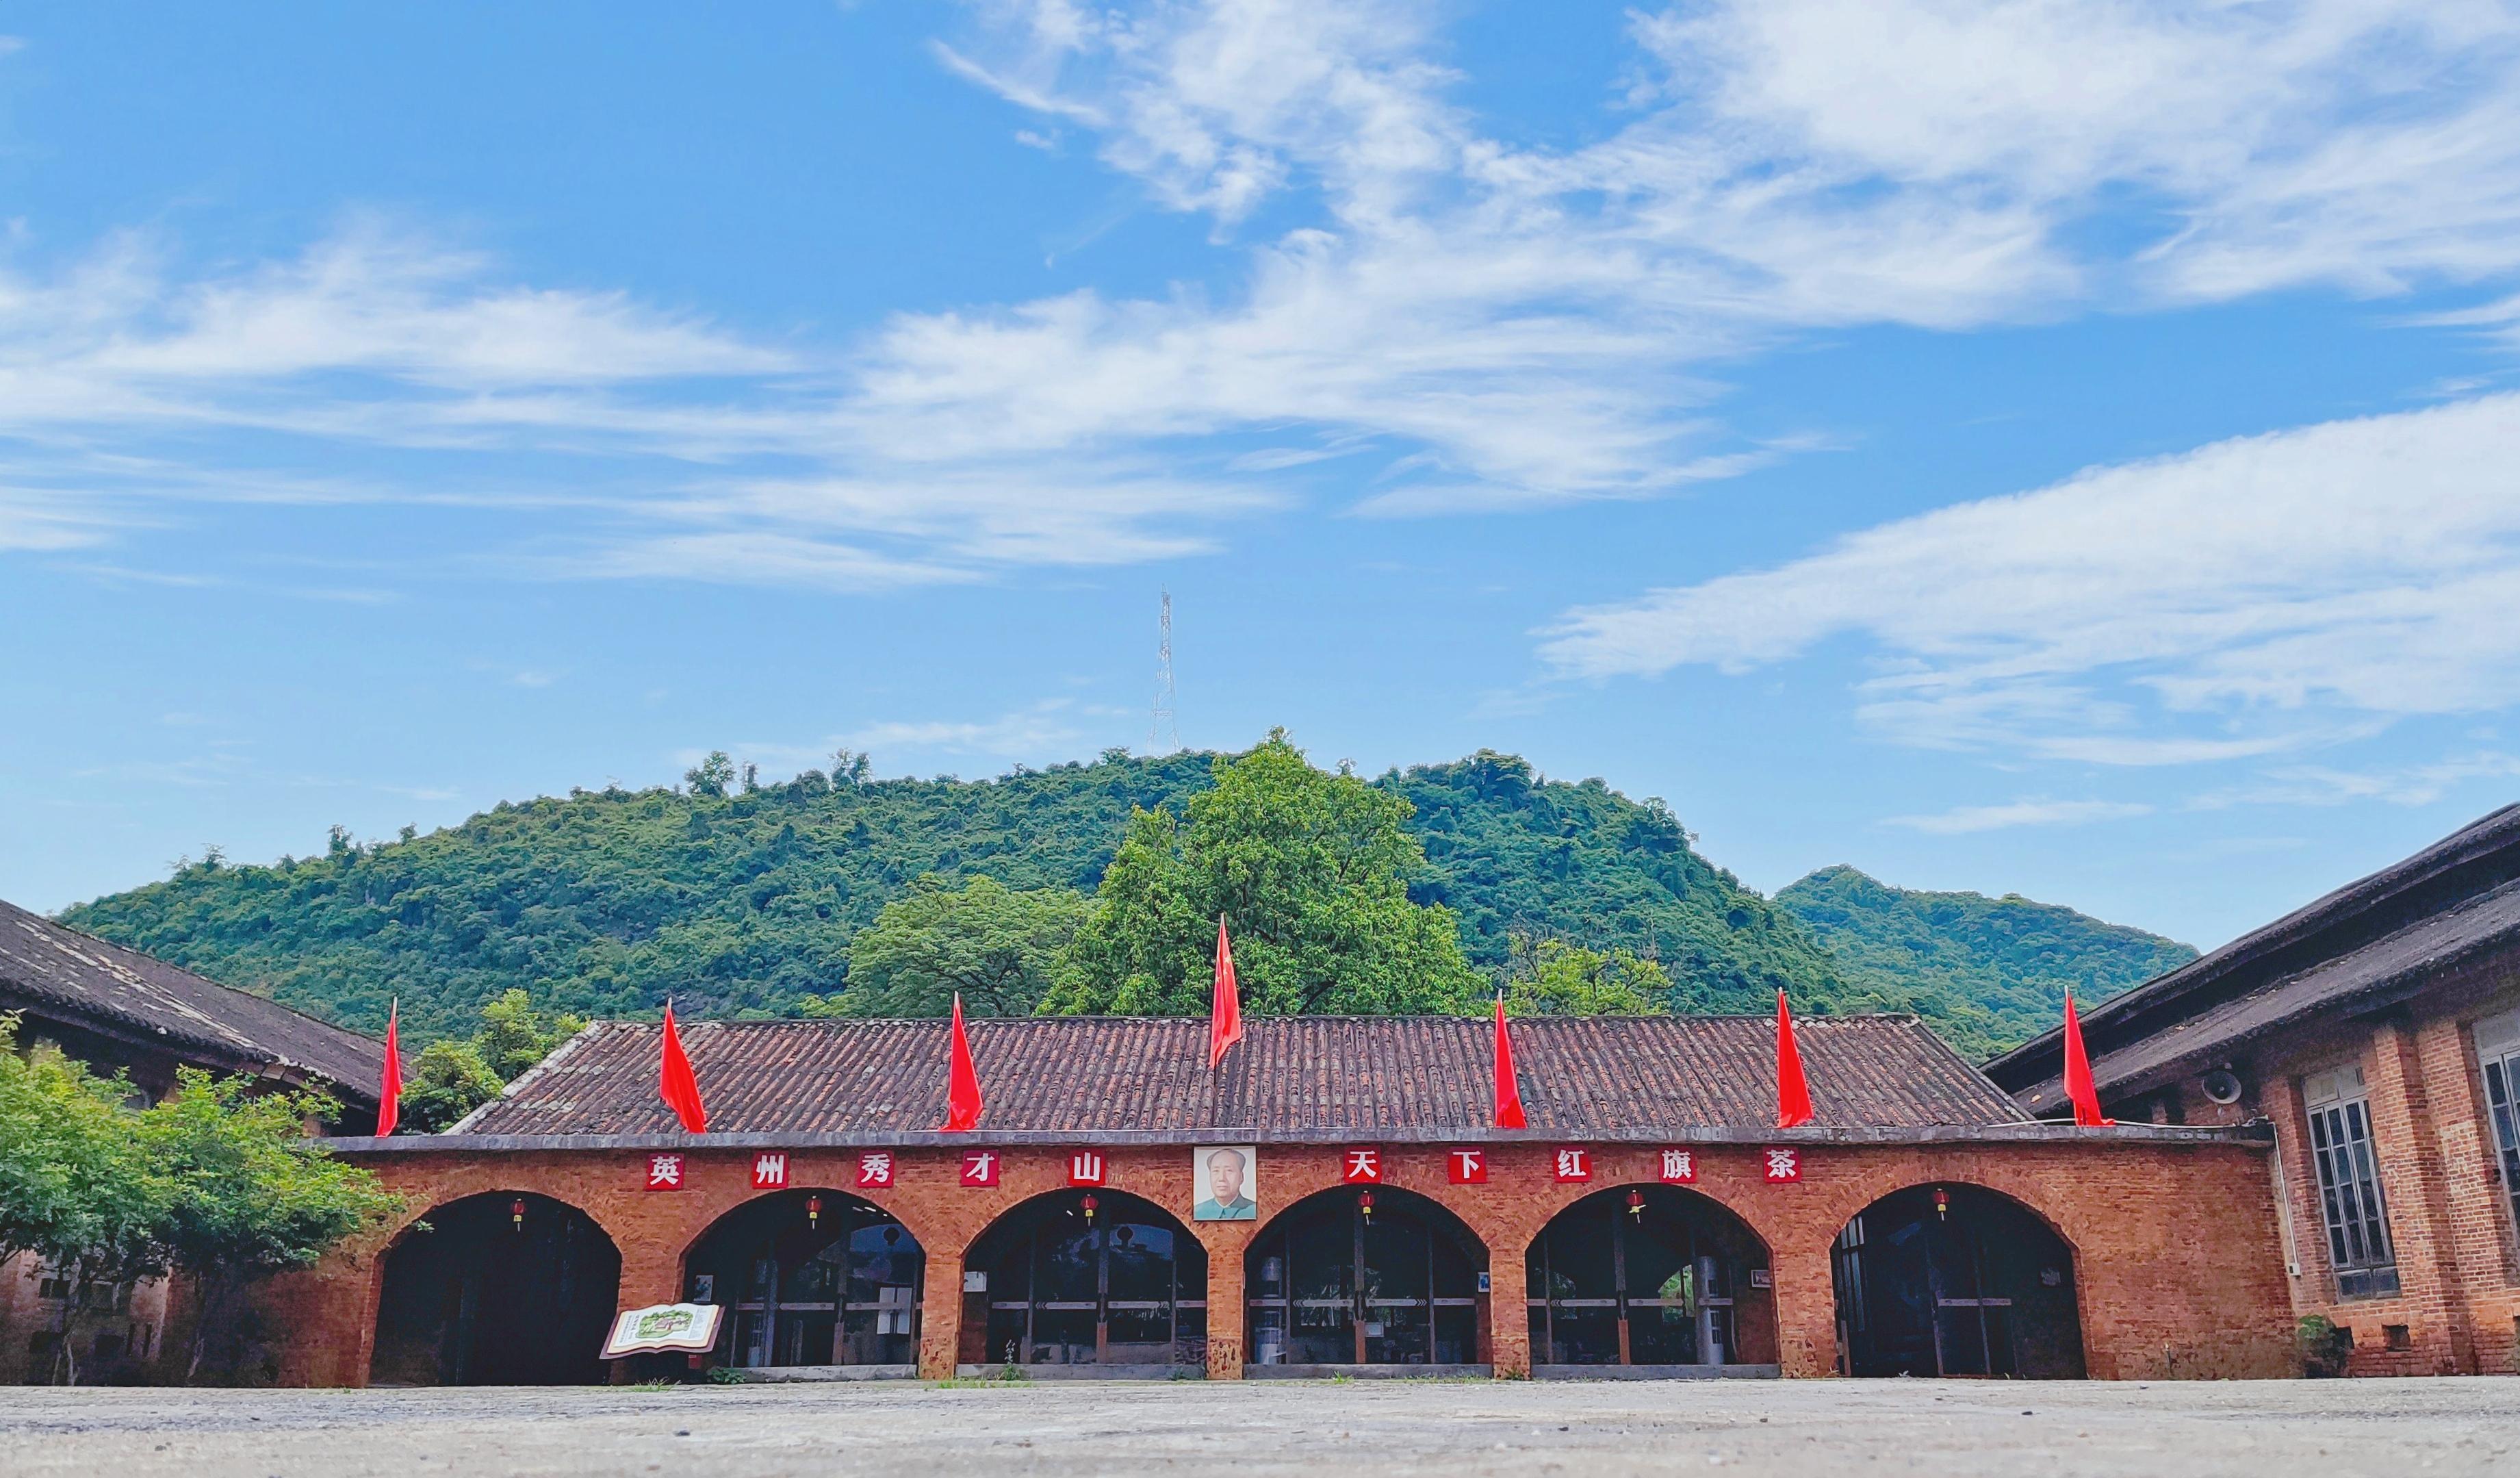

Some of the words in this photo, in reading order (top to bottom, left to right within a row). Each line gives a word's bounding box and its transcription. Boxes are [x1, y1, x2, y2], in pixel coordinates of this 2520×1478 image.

[650, 1152, 1101, 1186] 英州秀才山
[1349, 1149, 1796, 1179] 天下红旗茶
